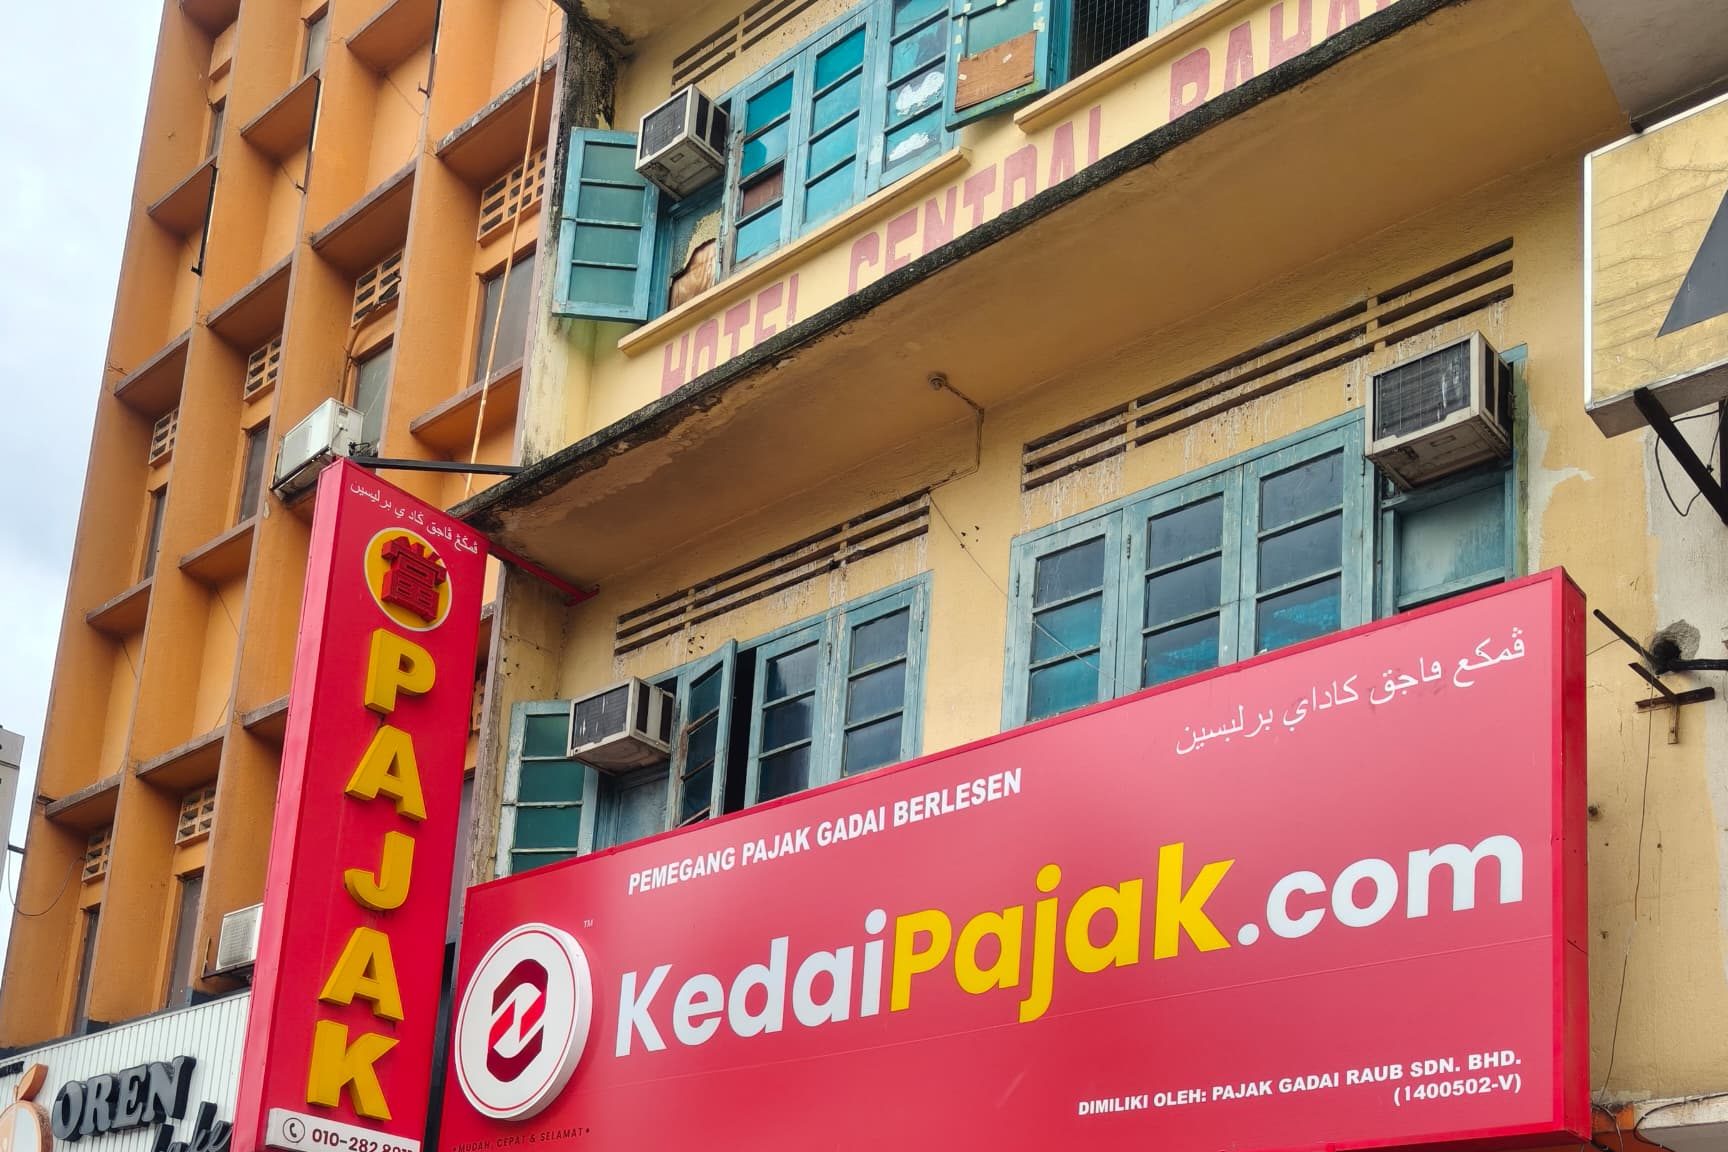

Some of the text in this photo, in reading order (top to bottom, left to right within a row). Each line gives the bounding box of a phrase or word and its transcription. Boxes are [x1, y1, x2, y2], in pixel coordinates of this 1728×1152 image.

[307, 628, 436, 1121] PAJAK
[628, 768, 1022, 895] PEMEGANG PAJAK GADAI BERLESEN
[616, 834, 1523, 1058] KedaiPajak.com
[52, 1055, 196, 1142] OREN
[1078, 1050, 1522, 1115] DIMILIKI OLEH: PAJAK GADAI RAUB SDN. BHD.
[1393, 1073, 1522, 1106] (1400502-V)
[540, 1127, 583, 1142] SELAMAT
